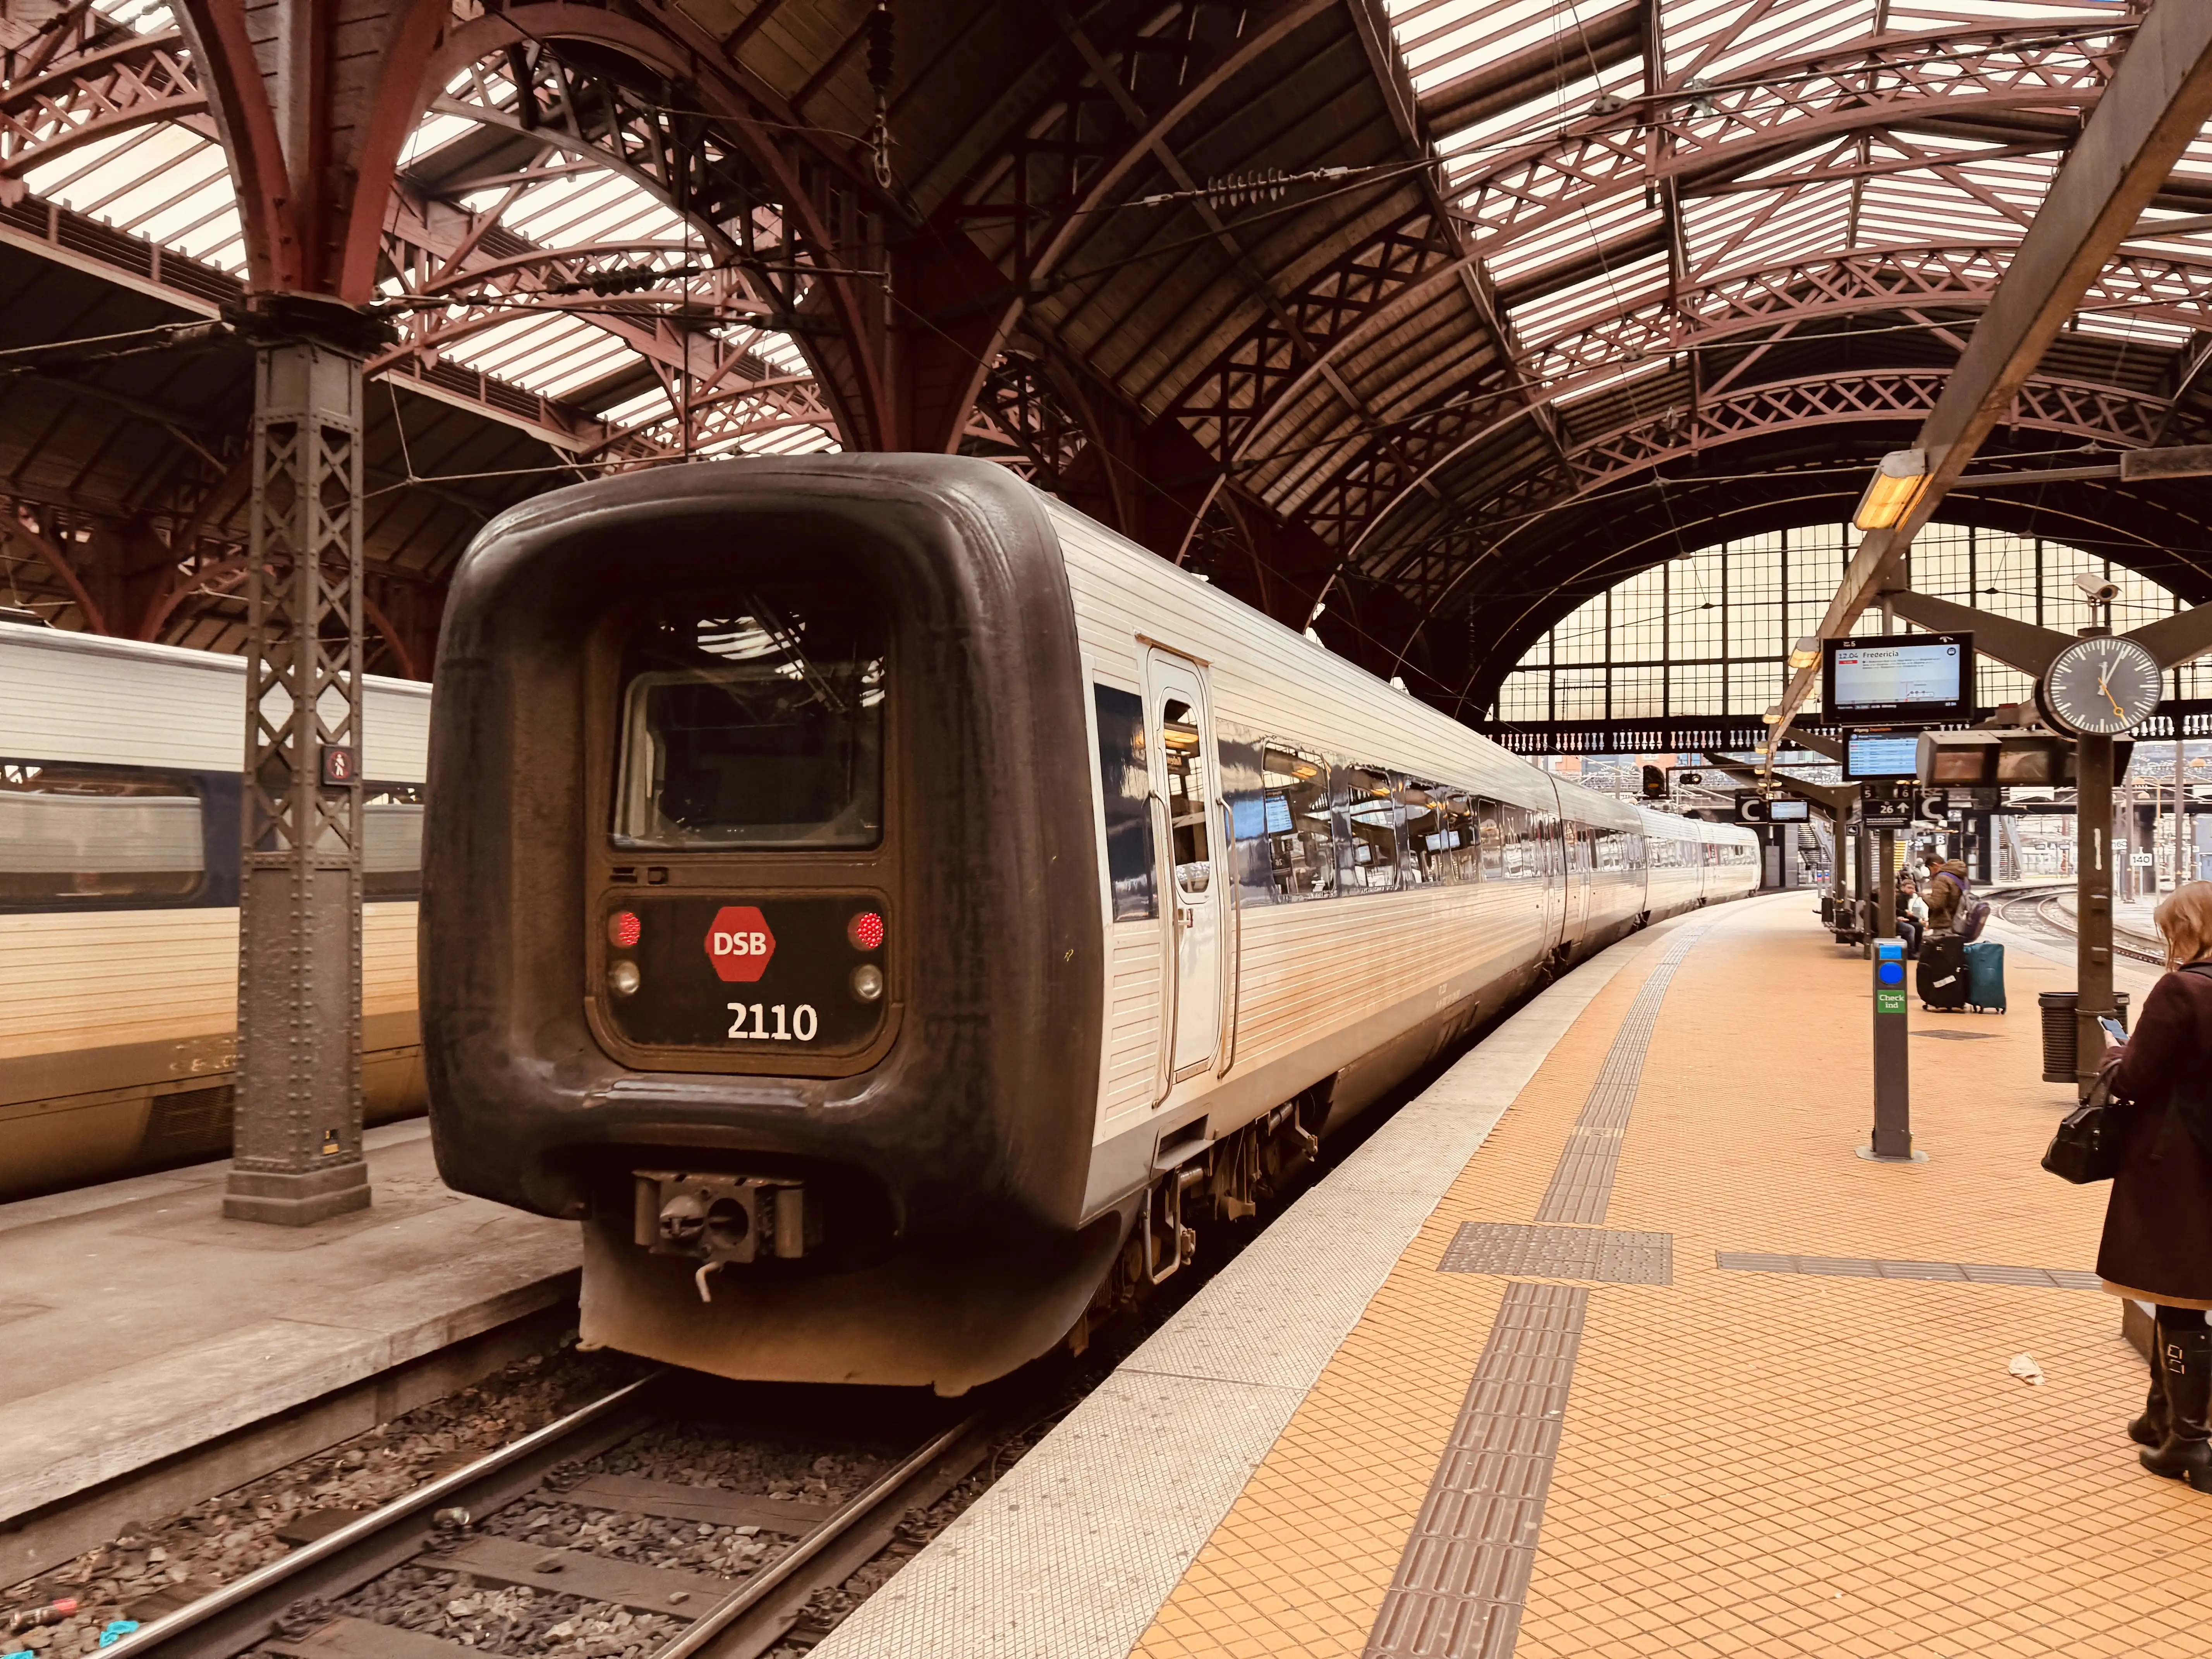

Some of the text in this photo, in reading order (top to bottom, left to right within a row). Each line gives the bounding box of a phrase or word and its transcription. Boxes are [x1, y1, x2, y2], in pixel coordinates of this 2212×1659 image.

[1865, 790, 1872, 798] 5
[1741, 800, 1760, 821] C
[1880, 805, 1894, 814] 26
[1922, 797, 1944, 820] C
[1936, 835, 1945, 844] B
[714, 932, 766, 955] DSB
[727, 1002, 818, 1041] 2110
